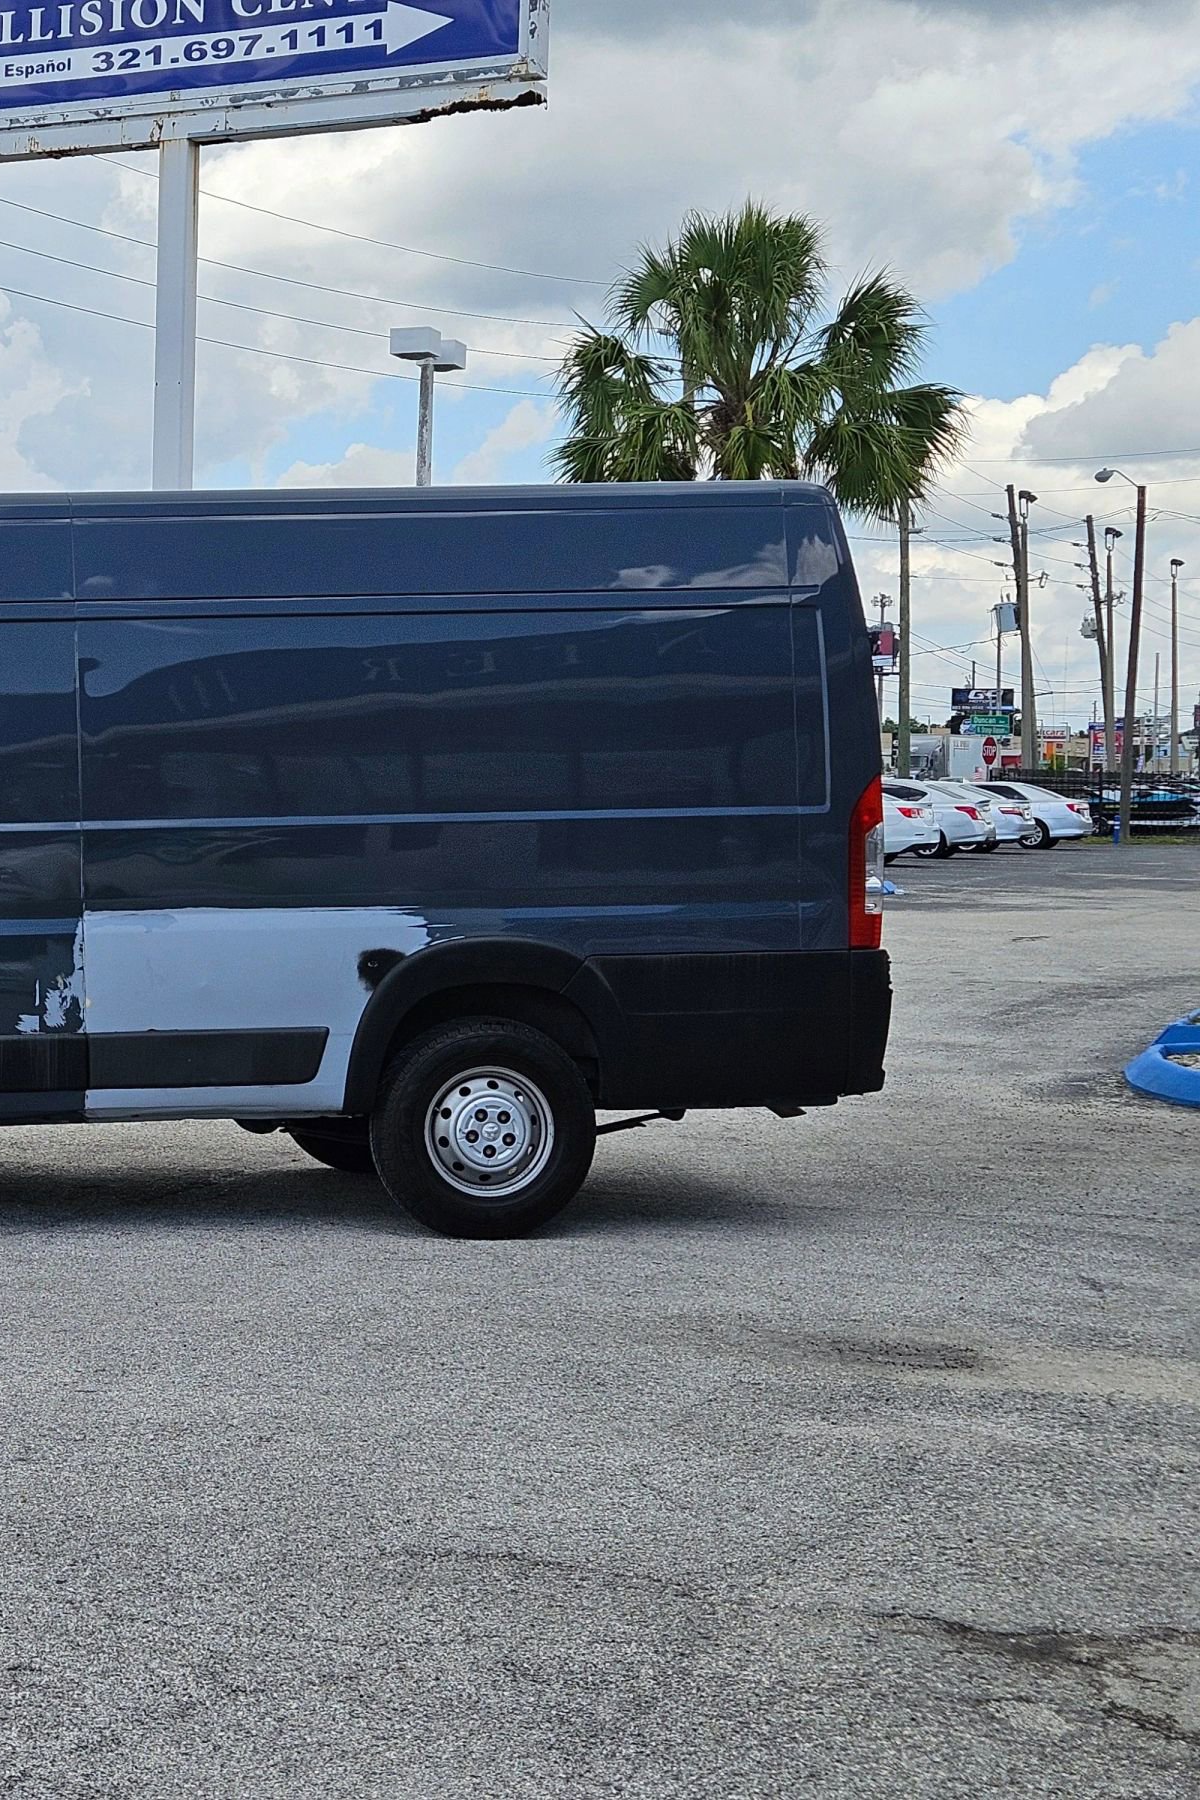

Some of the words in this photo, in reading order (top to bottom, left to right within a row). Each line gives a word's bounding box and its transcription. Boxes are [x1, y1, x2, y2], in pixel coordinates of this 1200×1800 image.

[4, 57, 72, 79] Español
[91, 18, 384, 73] 321.697.1111
[973, 716, 997, 724] Duncan
[983, 745, 997, 757] STOP
